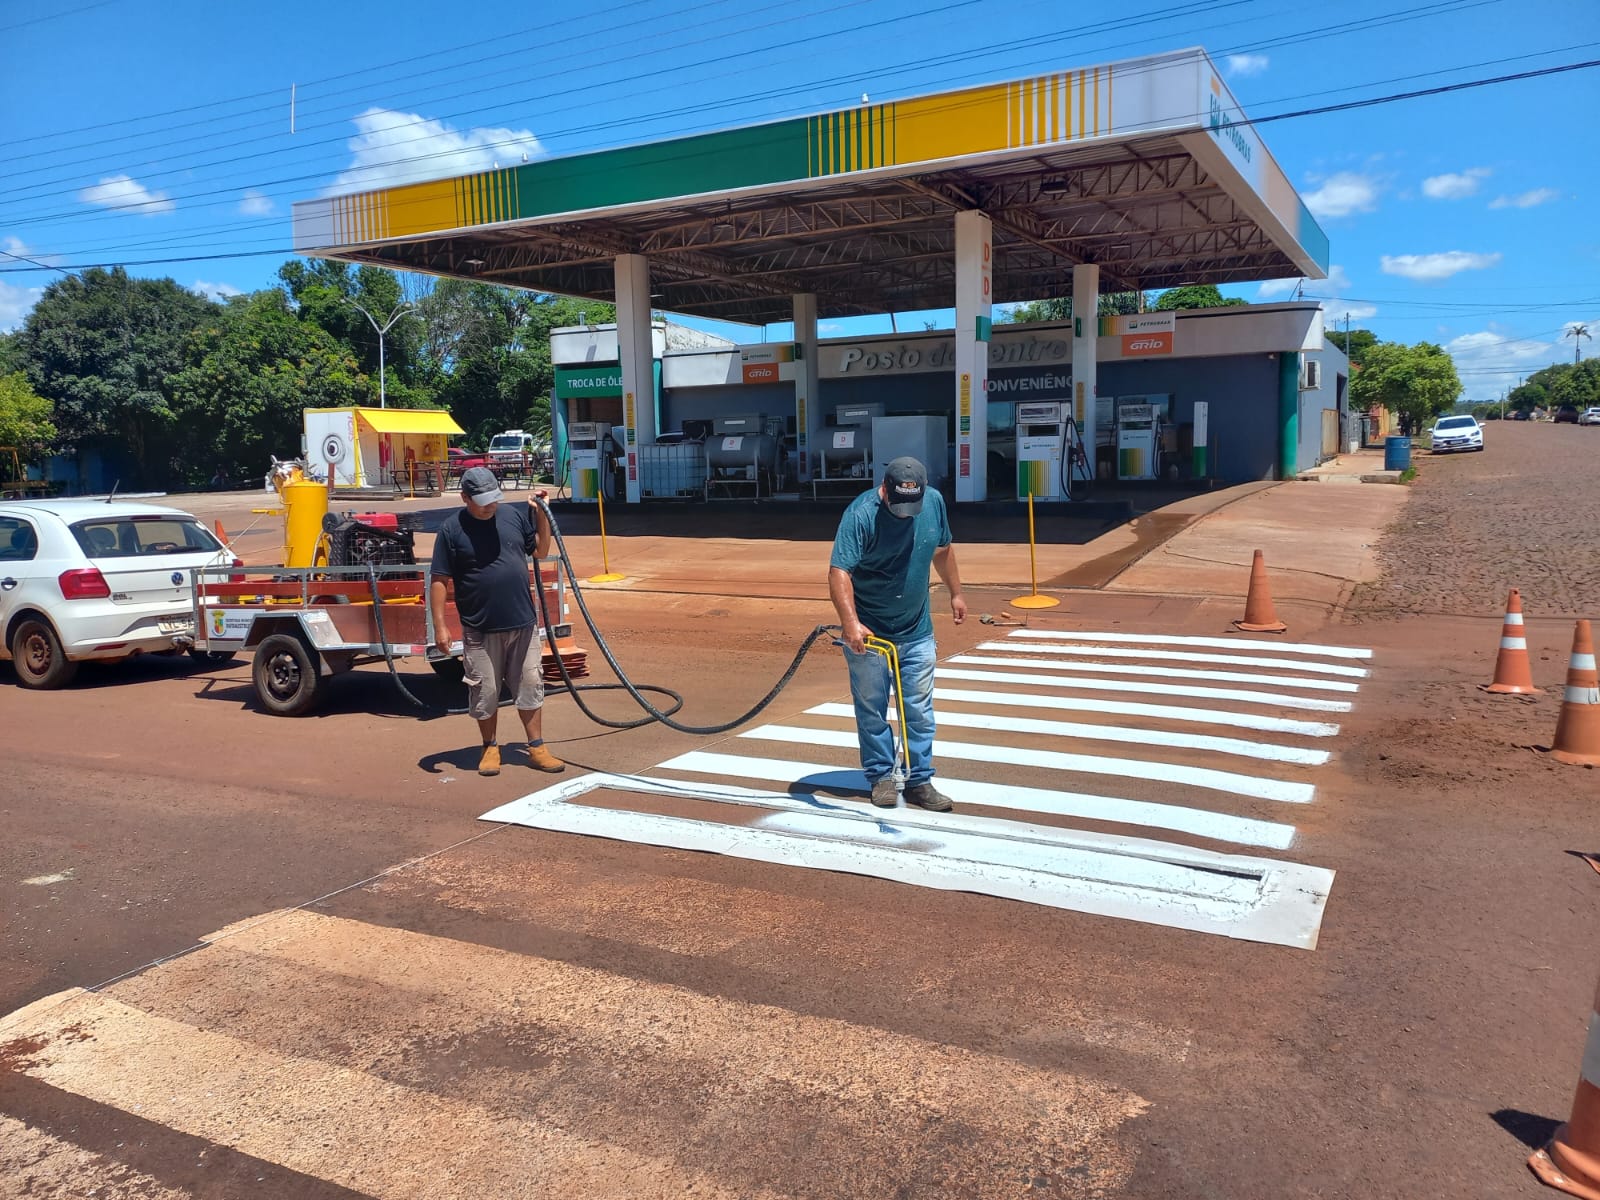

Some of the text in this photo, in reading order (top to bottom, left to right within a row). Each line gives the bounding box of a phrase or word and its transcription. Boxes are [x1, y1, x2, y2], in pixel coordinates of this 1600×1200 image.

[839, 345, 920, 373] Posto
[567, 378, 595, 389] TROCA
[595, 377, 607, 387] DE
